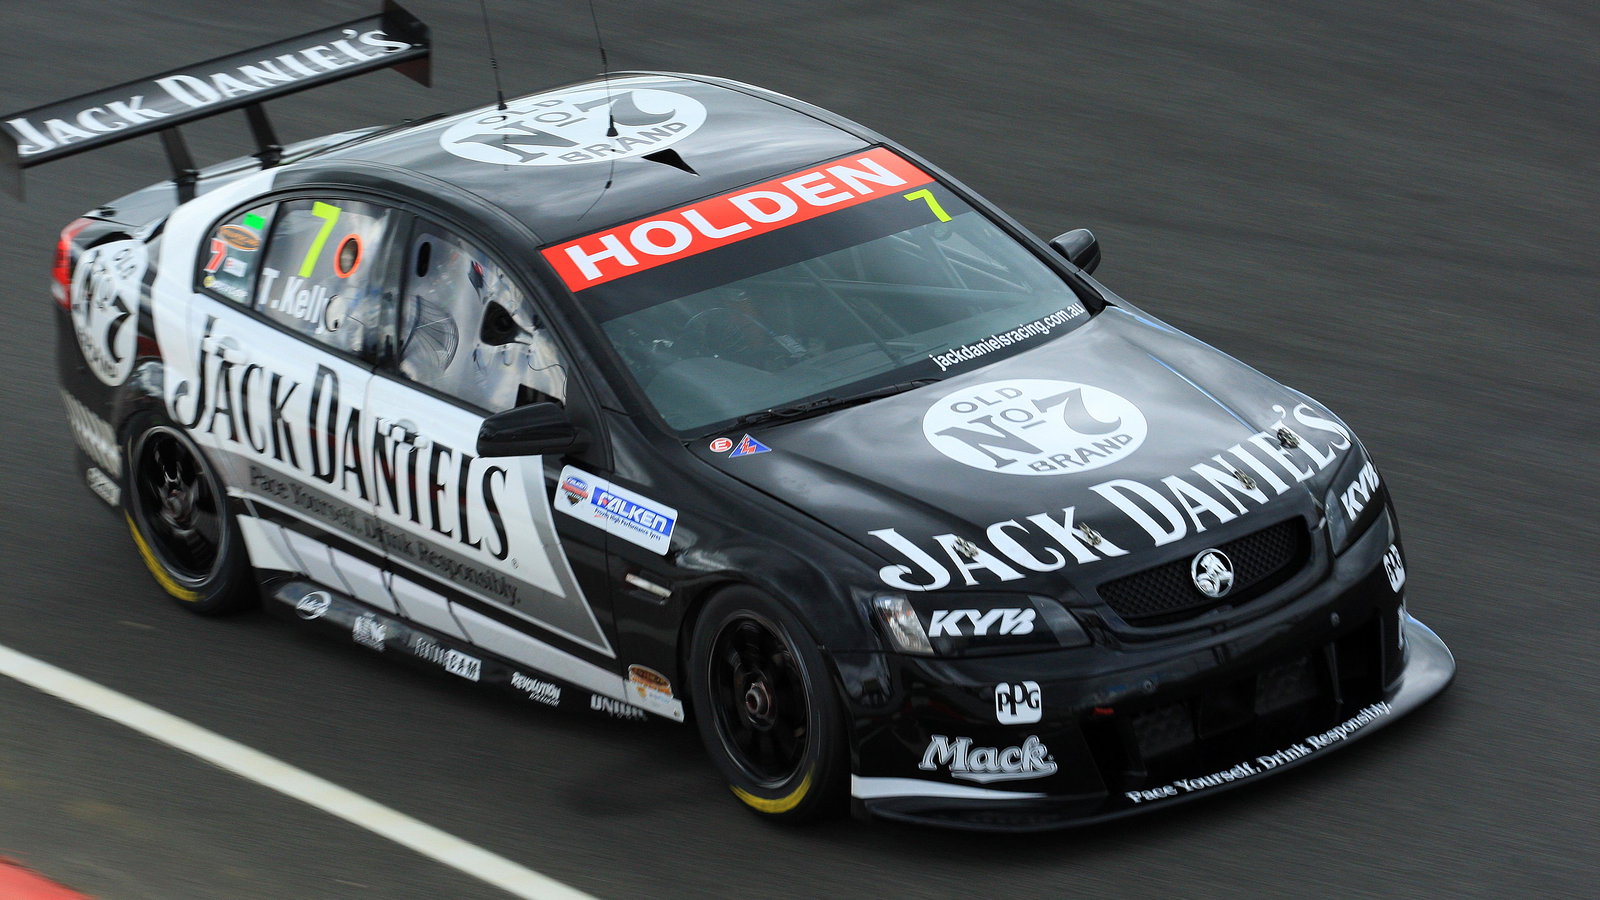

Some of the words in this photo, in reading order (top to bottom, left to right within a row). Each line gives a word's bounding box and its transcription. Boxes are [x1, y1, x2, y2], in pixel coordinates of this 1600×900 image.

[7, 95, 170, 155] JACK
[155, 28, 412, 108] DANIEL'S
[477, 98, 564, 125] OLD
[572, 90, 676, 127] 7
[557, 120, 687, 163] BRAND
[564, 156, 908, 281] HOLDEN
[903, 188, 952, 223] 7
[298, 201, 342, 278] 7
[929, 301, 1086, 371] jackdanielsracing.com.au
[171, 313, 304, 471] JACK
[949, 386, 1024, 414] OLD
[1030, 387, 1122, 435] 7
[1026, 432, 1133, 472] BRAND
[596, 491, 668, 534] FALKEN
[868, 505, 1130, 592] JACK
[1088, 403, 1352, 547] DANIEL'S
[1340, 460, 1381, 521] KYB
[928, 607, 1037, 637] KYB
[996, 681, 1041, 716] PPG
[918, 734, 1058, 778] Mack
[1125, 783, 1177, 804] Pace
[1256, 742, 1313, 770] Drink
